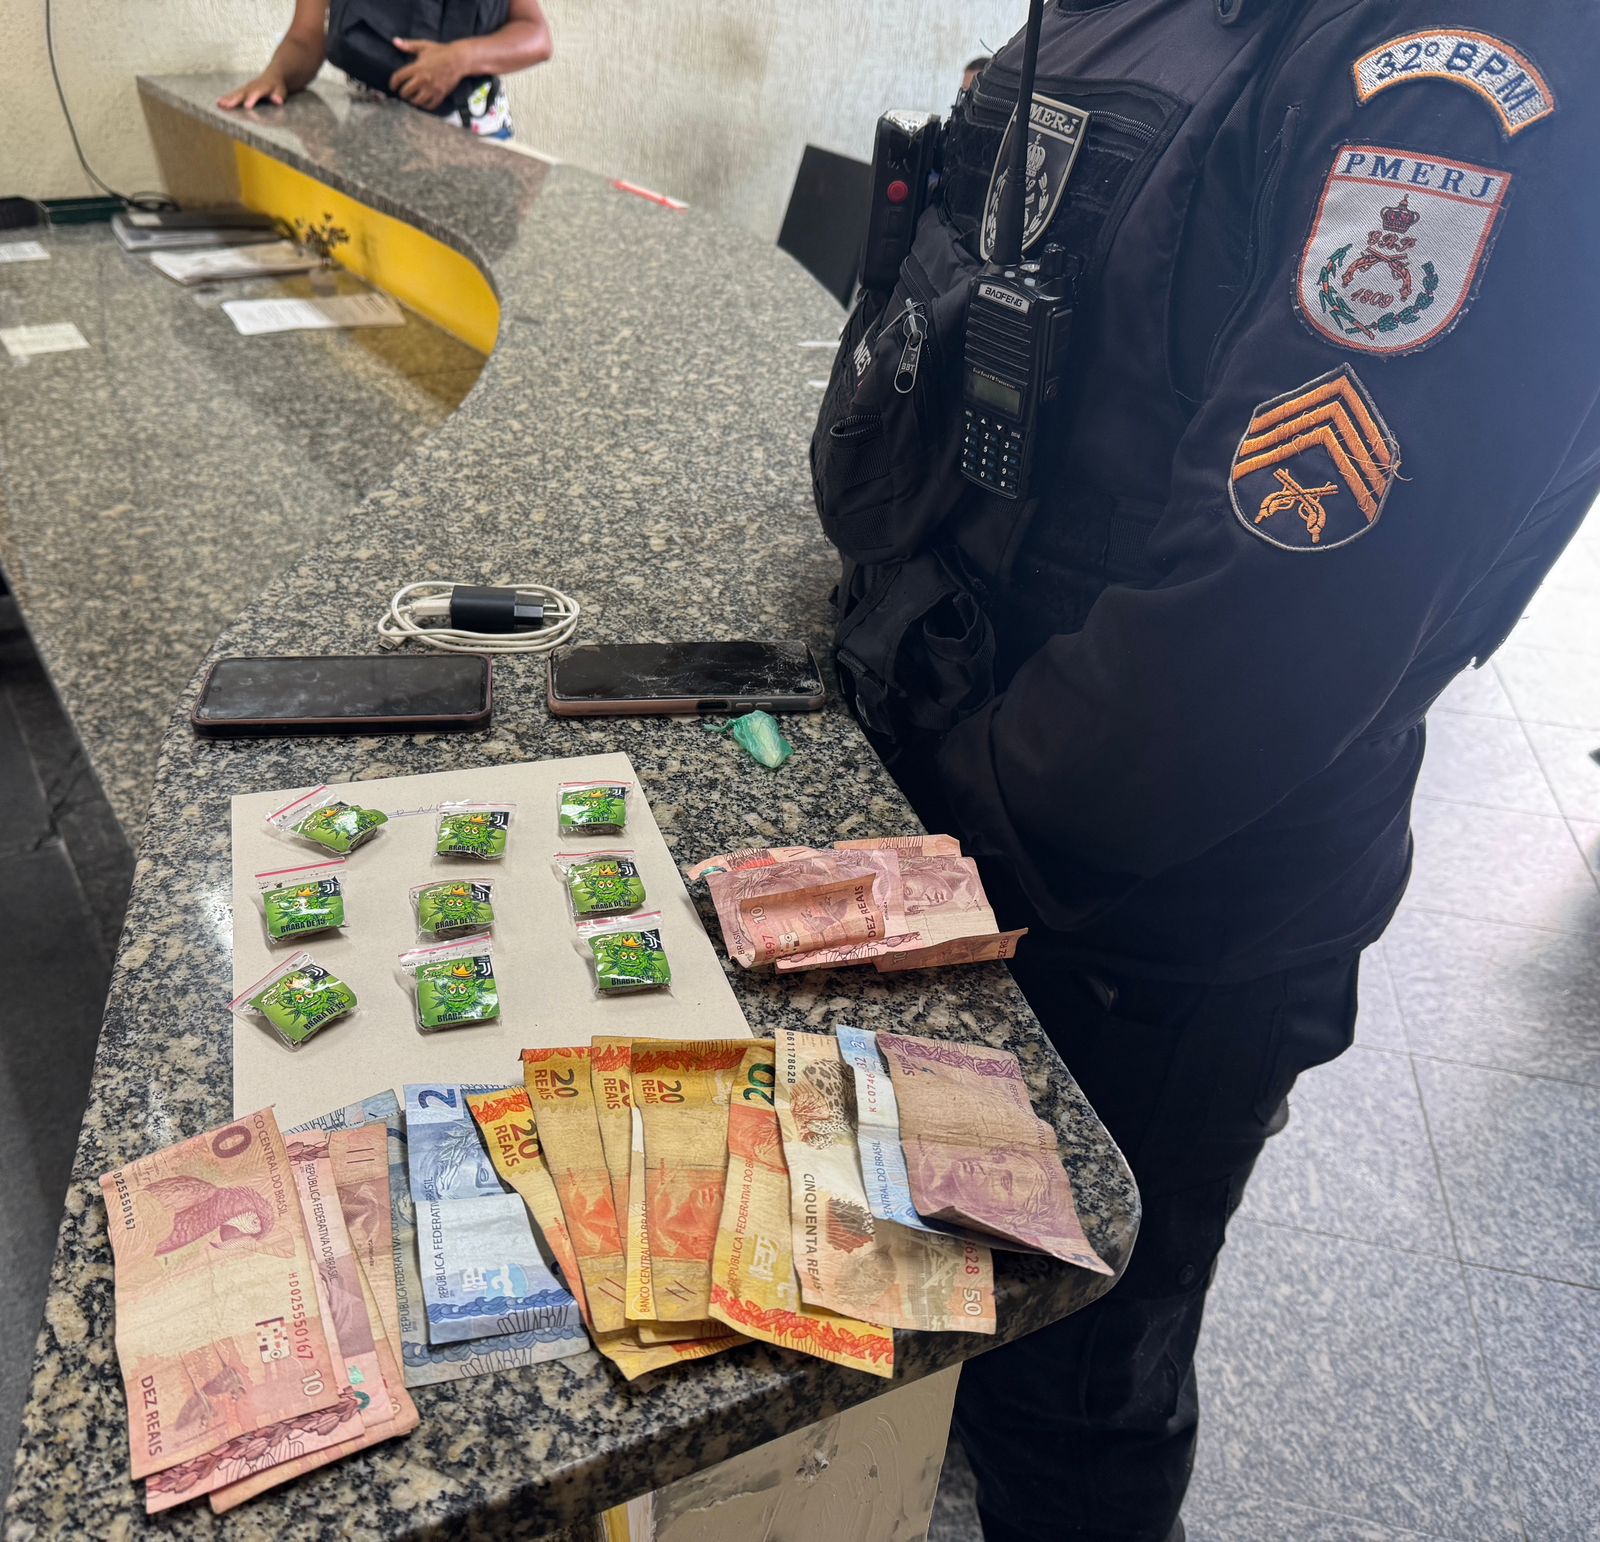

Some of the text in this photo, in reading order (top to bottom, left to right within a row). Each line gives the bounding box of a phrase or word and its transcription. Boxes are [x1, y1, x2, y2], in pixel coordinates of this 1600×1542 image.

[1446, 41, 1540, 113] BPM
[1029, 103, 1079, 134] MERJ
[1341, 152, 1496, 199] PMERJ
[985, 287, 1023, 308] BAOFENG
[1350, 288, 1394, 308] 1809
[281, 919, 306, 934] BRABA
[306, 919, 316, 928] DE
[750, 906, 767, 925] 10
[854, 885, 876, 939] DEZ REAIS
[732, 929, 746, 956] BRASIL
[303, 1013, 329, 1031] BRABA
[327, 1007, 338, 1016] DE
[850, 1040, 866, 1050] 2
[534, 1069, 554, 1100] REAIS
[551, 1068, 579, 1098] 20
[603, 1078, 621, 1110] REAIS
[641, 1079, 659, 1104] REAIS
[657, 1080, 685, 1104] 20
[743, 1063, 775, 1106] 20
[418, 1088, 457, 1110] 2
[494, 1124, 520, 1168] REAIS
[509, 1118, 543, 1160] 20
[253, 1112, 288, 1217] CO CENTRAL DO BRASIL
[873, 1140, 886, 1169] BRASIL
[876, 1169, 888, 1182] DO
[112, 1170, 136, 1231] 025550167
[735, 1184, 751, 1235] FEDERATIVA
[743, 1168, 754, 1183] DO
[304, 1163, 339, 1282] REPÚBLICA FEDERATIVA DO BRASIL
[640, 1231, 650, 1244] DO
[803, 1173, 824, 1295] CINQUENTA REAIS
[434, 1251, 449, 1299] REPÚBLICA
[640, 1244, 651, 1284] CENTRAL
[640, 1286, 650, 1313] BANCO
[962, 1288, 982, 1317] 50
[301, 1369, 325, 1397] 10
[141, 1375, 163, 1457] DEZ REAIS
